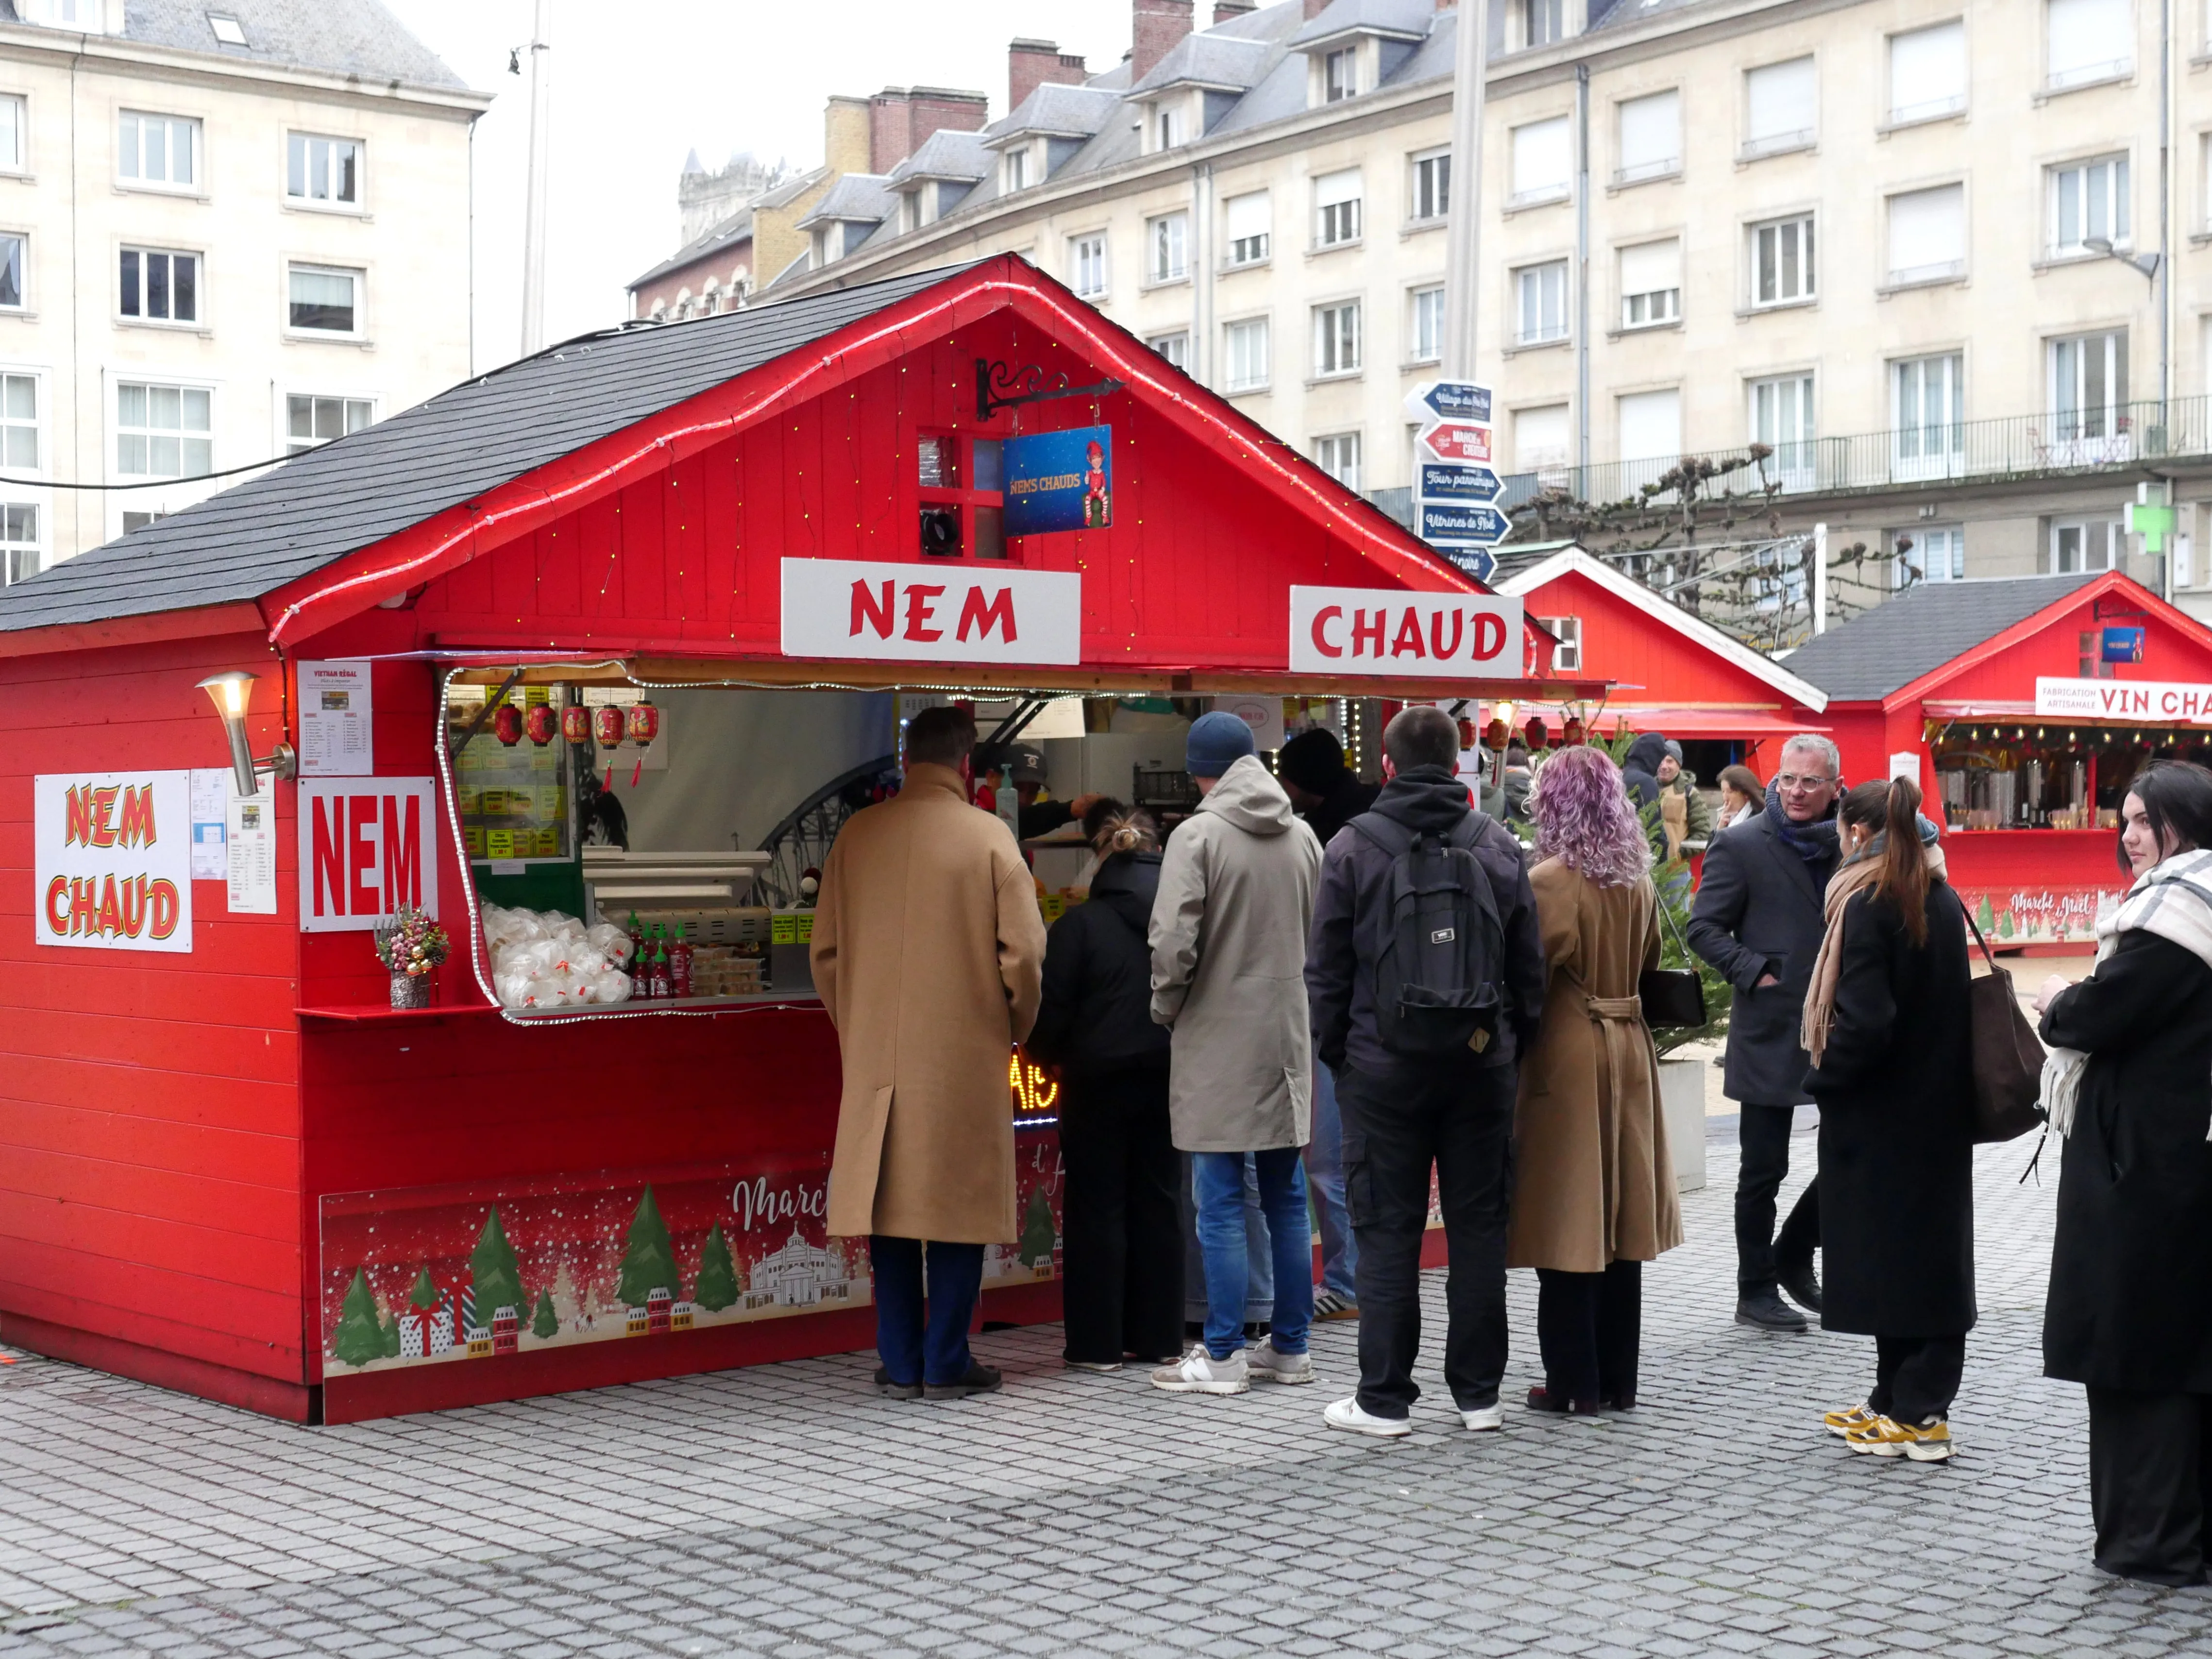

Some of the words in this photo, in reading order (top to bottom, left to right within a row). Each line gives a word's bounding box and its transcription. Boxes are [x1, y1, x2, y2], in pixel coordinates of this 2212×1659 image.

[1010, 478, 1038, 495] NEMS
[1039, 473, 1081, 491] CHAUDS
[1427, 471, 1452, 485] Tour
[1425, 513, 1467, 528] Vitrines
[849, 578, 1017, 644] NEM
[1311, 605, 1506, 661] CHAUD
[2043, 687, 2096, 697] FABRICATION
[2047, 700, 2095, 709] ARTISANALE
[2100, 689, 2149, 714] VIN
[65, 781, 156, 850] NEM
[312, 795, 422, 916] NEM
[46, 872, 180, 940] CHAUD
[2011, 890, 2055, 914] Marché
[2062, 893, 2090, 917] Noël
[733, 1176, 827, 1231] Marc
